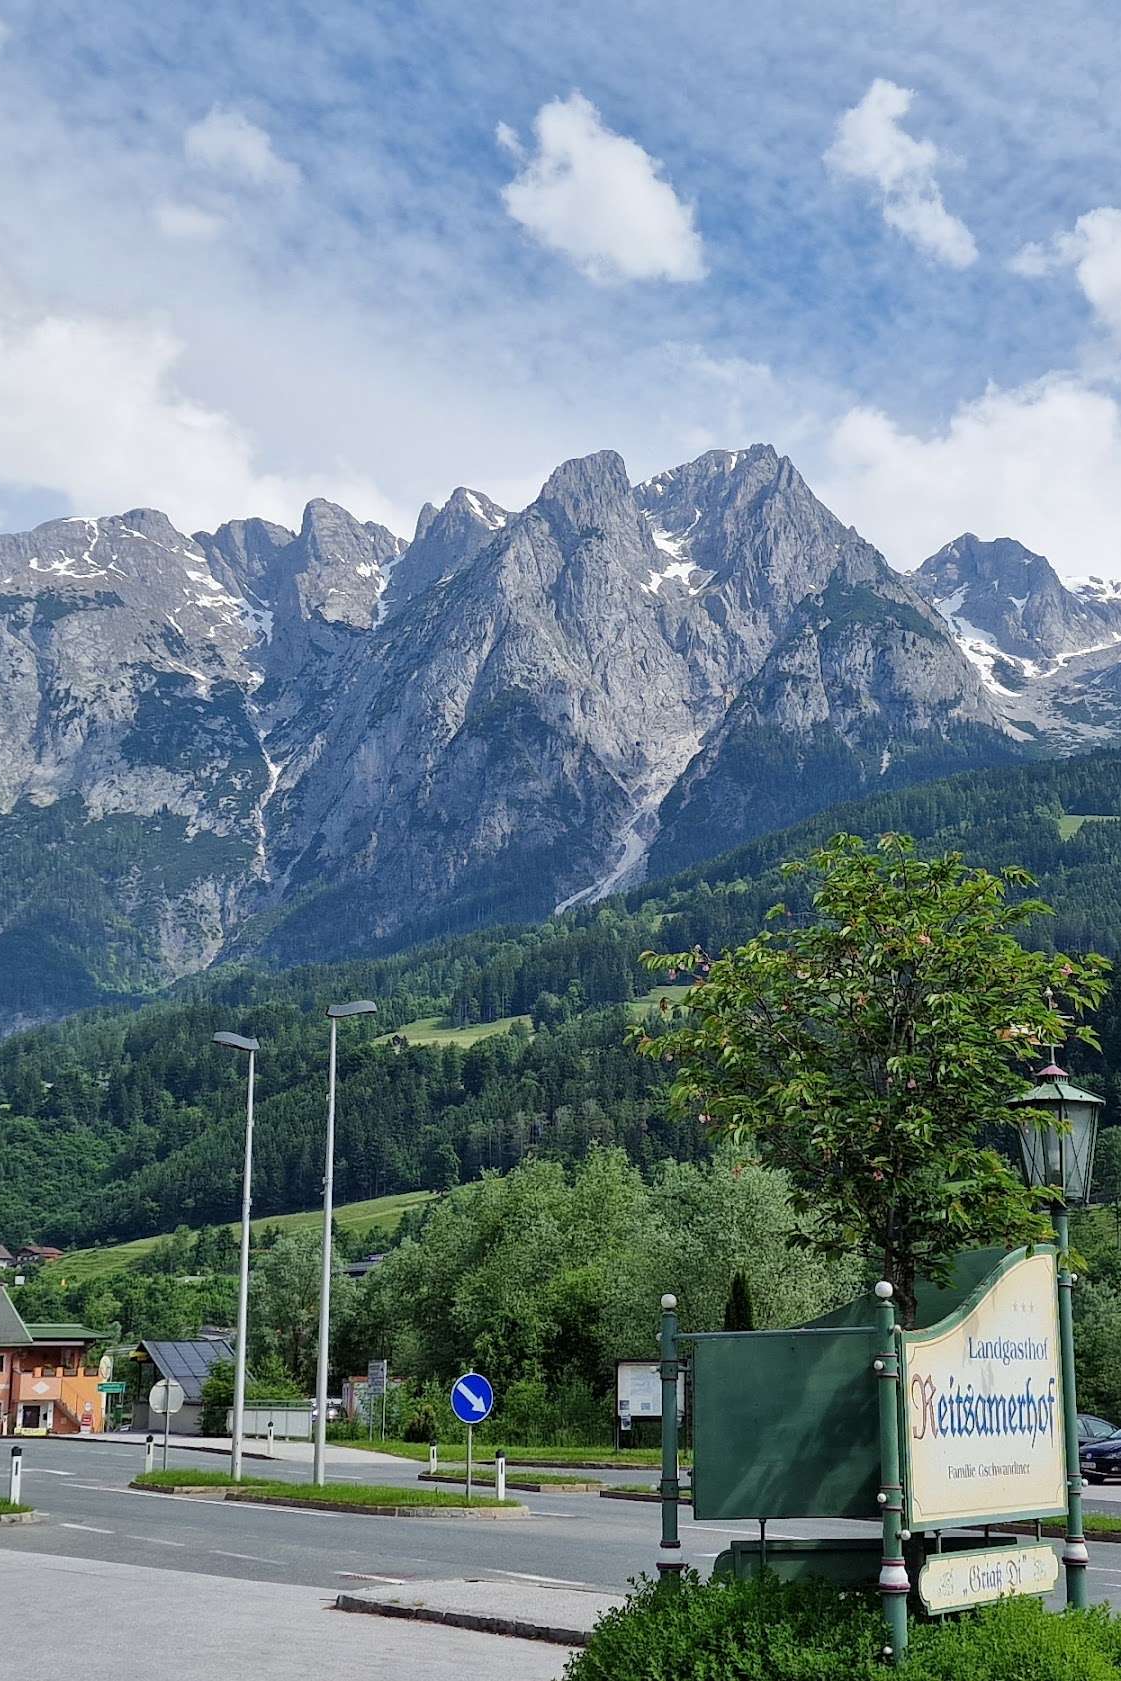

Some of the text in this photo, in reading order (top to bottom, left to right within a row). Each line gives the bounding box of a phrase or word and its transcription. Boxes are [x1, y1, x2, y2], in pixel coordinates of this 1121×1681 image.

[968, 1336, 1048, 1366] Landgasthof
[911, 1373, 1055, 1449] Reitsamerhof
[948, 1463, 976, 1479] Familie
